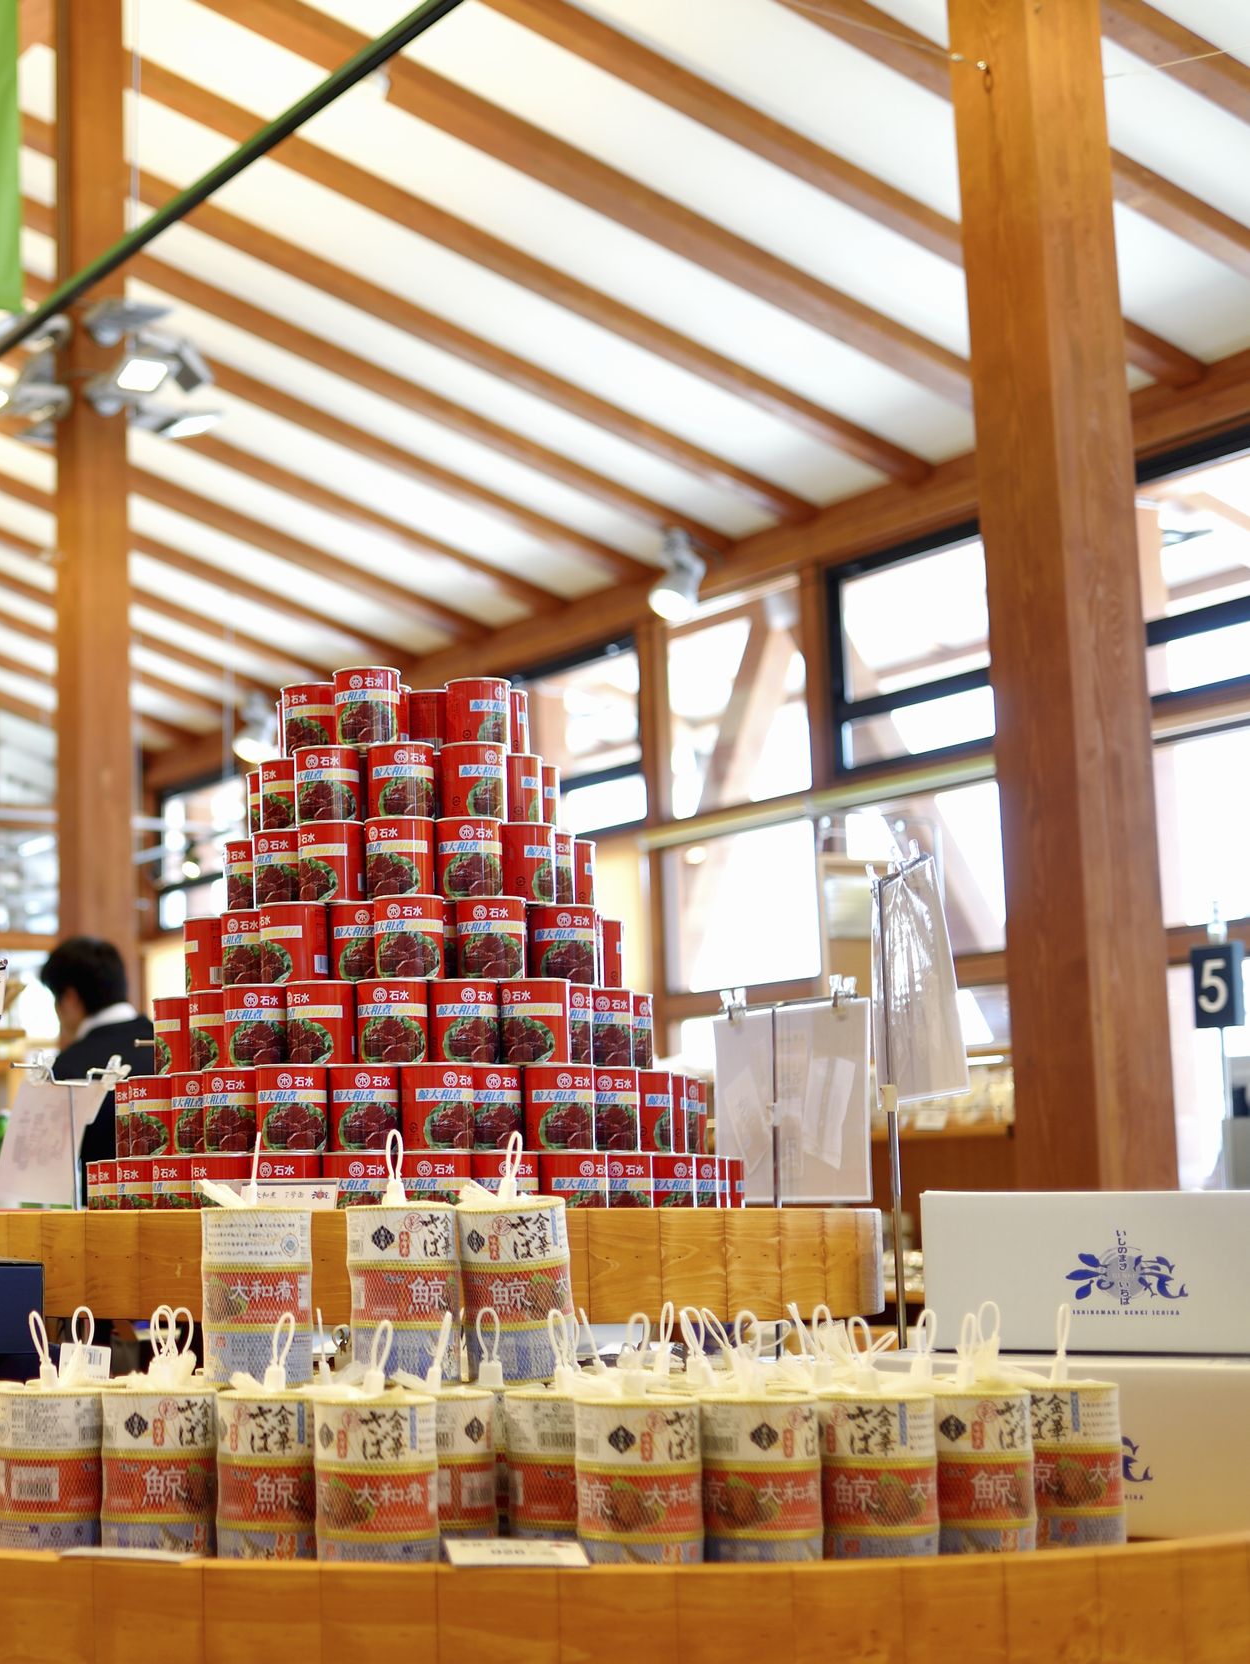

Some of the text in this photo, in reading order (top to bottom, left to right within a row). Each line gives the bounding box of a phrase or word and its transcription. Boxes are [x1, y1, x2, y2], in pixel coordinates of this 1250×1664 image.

[365, 677, 383, 687] 石水
[291, 694, 307, 704] 石水
[320, 757, 339, 766] 石水
[411, 752, 426, 762] 石水
[263, 770, 276, 780] 石水
[374, 766, 413, 777] 鯨大和煮
[302, 833, 315, 843] 石水
[379, 828, 398, 838] 石水
[476, 828, 493, 838] 石水
[270, 840, 289, 850] 石水
[231, 850, 246, 860] 石水
[403, 906, 422, 916] 石水
[489, 908, 508, 918] 石水
[239, 920, 258, 930] 石水
[573, 915, 590, 925] 石水
[334, 927, 374, 937] 鯨大和煮
[536, 929, 576, 940] 鯨大和煮
[1198, 958, 1228, 1013] 5
[260, 995, 278, 1005] 石水
[293, 993, 309, 1003] 石水
[389, 990, 409, 1001] 石水
[477, 991, 493, 1000] 石水
[512, 991, 531, 1001] 石水
[612, 1000, 627, 1009] 石水
[437, 1005, 480, 1016] 鯨大和煮
[226, 1080, 245, 1090] 石水
[295, 1077, 313, 1087] 石水
[372, 1076, 390, 1086] 石水
[459, 1075, 472, 1085] 石水
[502, 1077, 517, 1087] 石水
[574, 1077, 590, 1087] 石水
[615, 1079, 632, 1089] 石水
[133, 1087, 147, 1097] 石水
[418, 1089, 462, 1100] 鯨大和煮
[534, 1090, 576, 1101] 鯨大和煮
[160, 1168, 177, 1178] 石水
[193, 1167, 207, 1177] 石水
[274, 1165, 294, 1176] 石水
[366, 1165, 385, 1175] 石水
[435, 1164, 454, 1174] 石水
[626, 1166, 644, 1175] 石水
[123, 1170, 139, 1179] 石水
[554, 1179, 598, 1189] 鯨大和煮
[419, 1213, 440, 1257] さば
[510, 1215, 534, 1259] さば
[533, 1213, 551, 1258] 金華
[229, 1279, 295, 1301] 大和煮
[408, 1275, 448, 1314] 鯨
[490, 1277, 532, 1313] 鯨
[1046, 1393, 1068, 1441] 金華
[250, 1406, 275, 1454] さば
[274, 1404, 295, 1455] 金華
[847, 1406, 878, 1455] さば
[873, 1405, 897, 1456] 金華
[142, 1466, 187, 1508] 鯨
[970, 1470, 1017, 1512] 鯨
[253, 1473, 299, 1513] 鯨
[354, 1482, 424, 1506] 大和煮
[832, 1473, 879, 1512] 鯨
